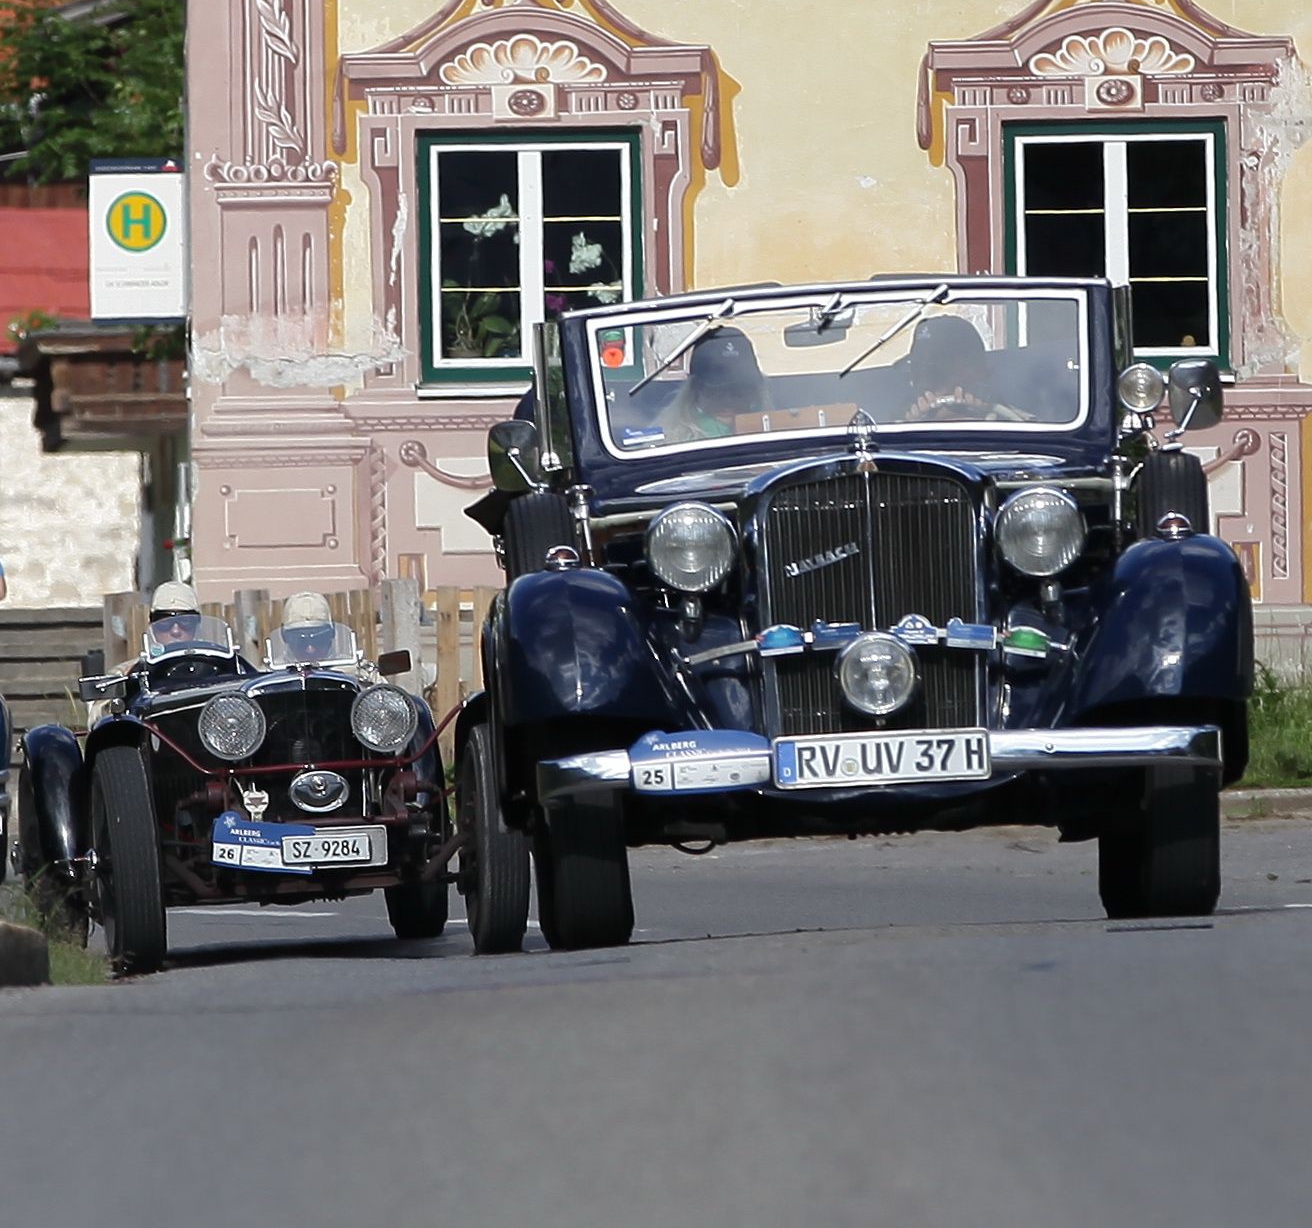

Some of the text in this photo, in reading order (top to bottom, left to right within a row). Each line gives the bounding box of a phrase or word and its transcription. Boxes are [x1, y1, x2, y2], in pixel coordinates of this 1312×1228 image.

[122, 204, 151, 239] H
[652, 740, 697, 752] ARLBERG
[797, 745, 841, 778] RV
[860, 741, 904, 774] UV
[642, 770, 664, 785] 25
[218, 848, 235, 860] 26
[292, 841, 312, 858] SZ
[321, 839, 361, 857] 9284
